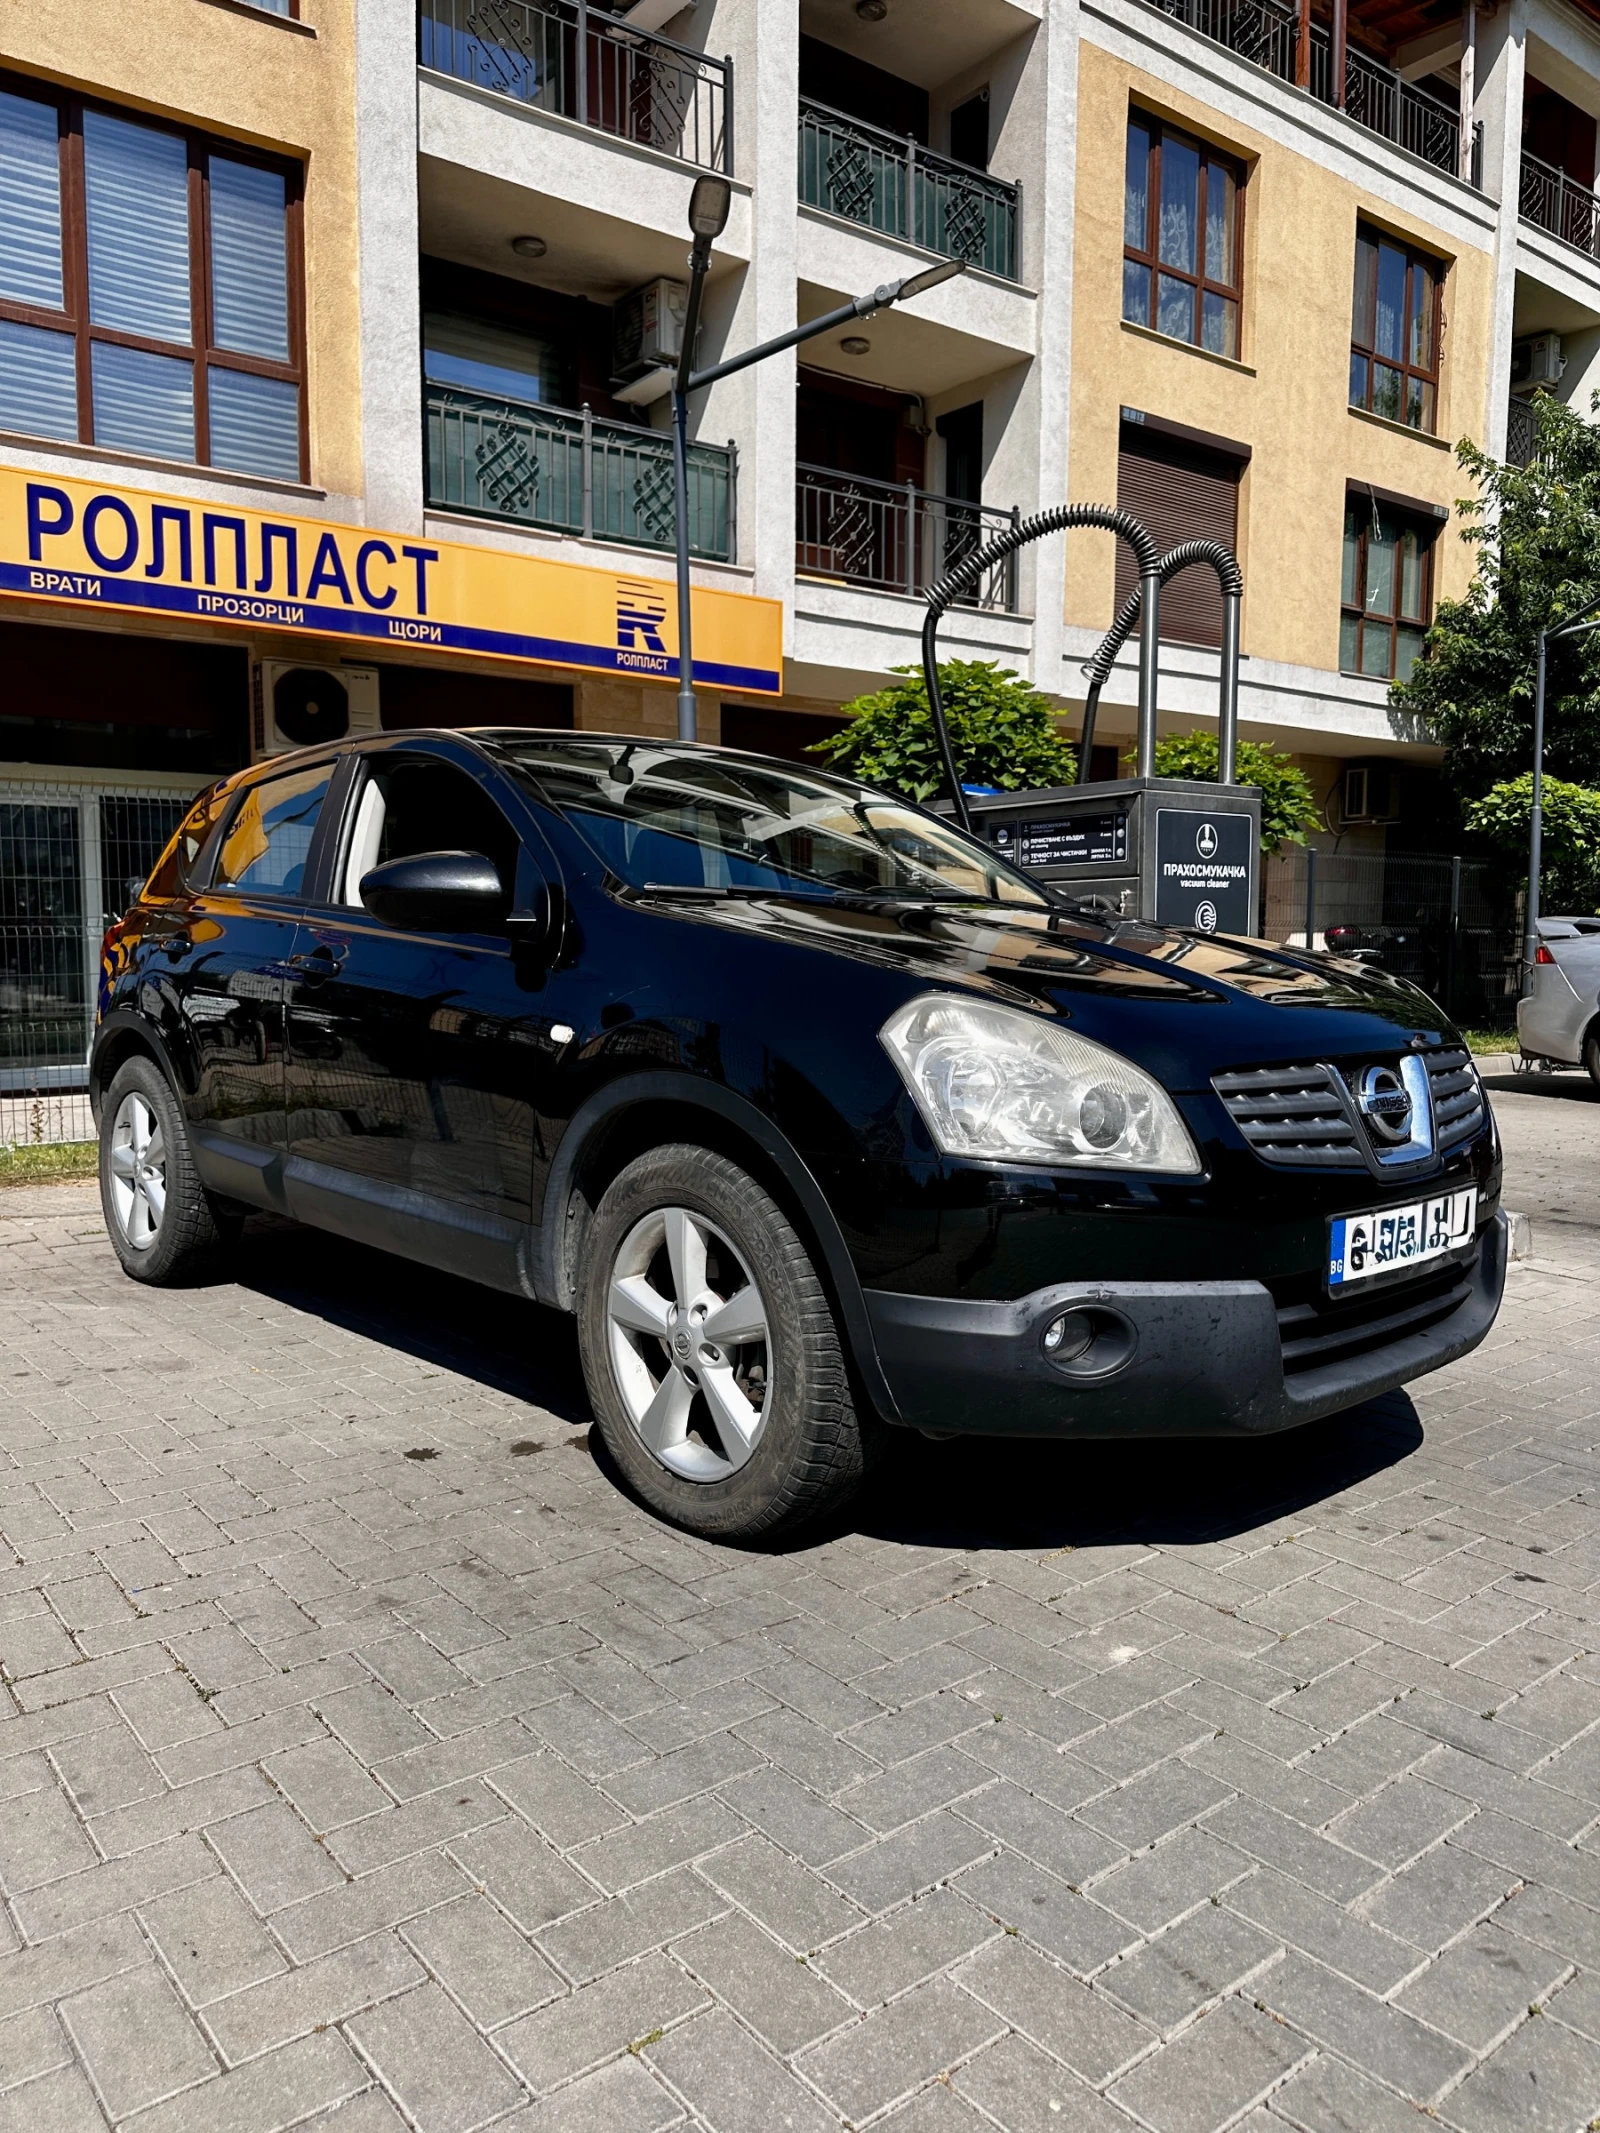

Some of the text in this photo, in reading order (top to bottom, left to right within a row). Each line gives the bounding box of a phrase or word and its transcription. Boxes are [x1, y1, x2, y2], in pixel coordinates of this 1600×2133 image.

[26, 483, 439, 616] РОЛПЛАСТ
[30, 571, 101, 596] ВРАТИ
[198, 594, 304, 624] ПРОЗОРЦИ
[389, 620, 442, 642] ЩОРИ
[616, 652, 669, 671] РОЛПЛАСТ
[1163, 863, 1246, 878] ПРАХОСМУКАЧКА
[1180, 878, 1230, 888] vacuum cleaner
[1330, 1259, 1343, 1275] BG
